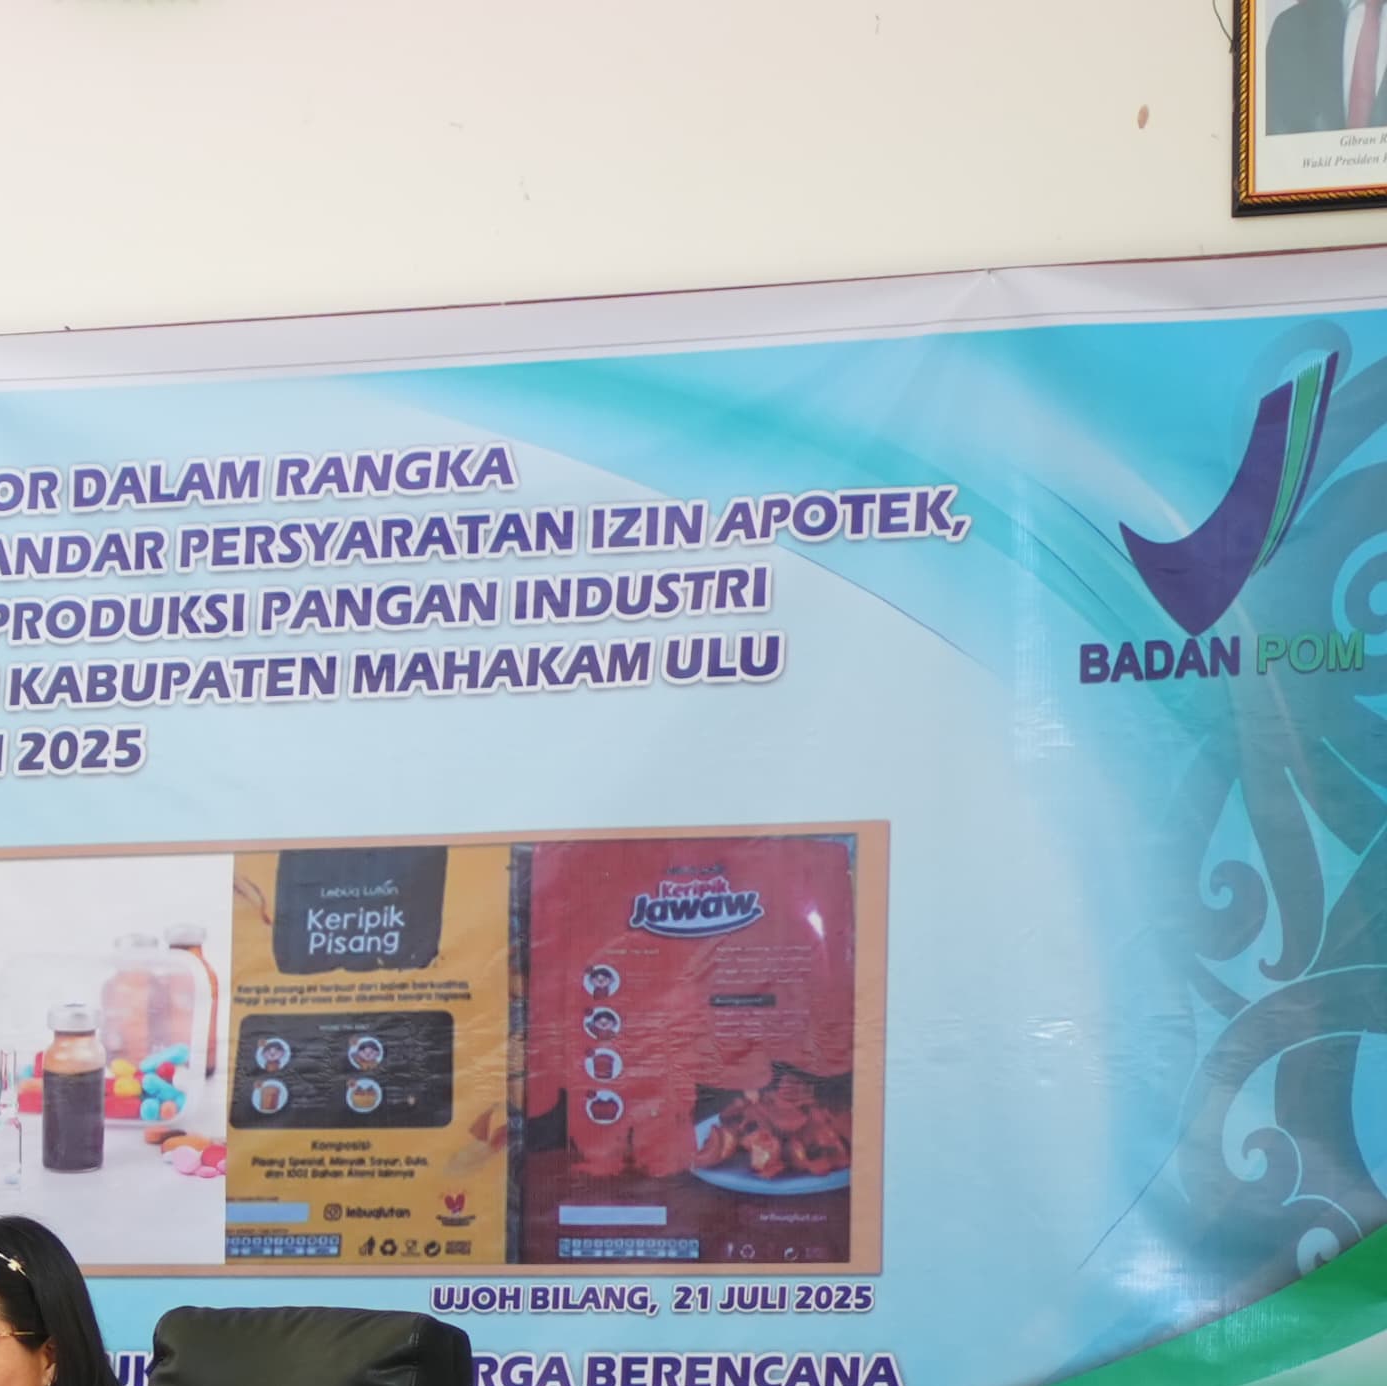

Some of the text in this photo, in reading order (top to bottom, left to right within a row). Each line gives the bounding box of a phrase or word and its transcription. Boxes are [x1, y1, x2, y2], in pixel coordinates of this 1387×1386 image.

[74, 461, 260, 507] DALAM
[277, 448, 513, 496] RANGKA
[181, 511, 573, 567] PERSYARATAN
[592, 505, 703, 548] IZIN
[716, 490, 966, 542] APOTEK,
[262, 582, 497, 630] PANGAN
[515, 567, 766, 619] INDUSTRI
[11, 656, 336, 705] KABUPATEN
[354, 642, 651, 692] MAHAKAM
[667, 636, 779, 679] ULU
[1082, 631, 1364, 683] BADAN POM
[19, 729, 141, 770] 2025
[660, 877, 728, 898] Keripik
[307, 904, 405, 934] Keripik
[632, 893, 758, 926] Jawaw
[309, 931, 400, 955] Pisang
[433, 1285, 872, 1313] UJOH BILANG, 21 JULI 2025
